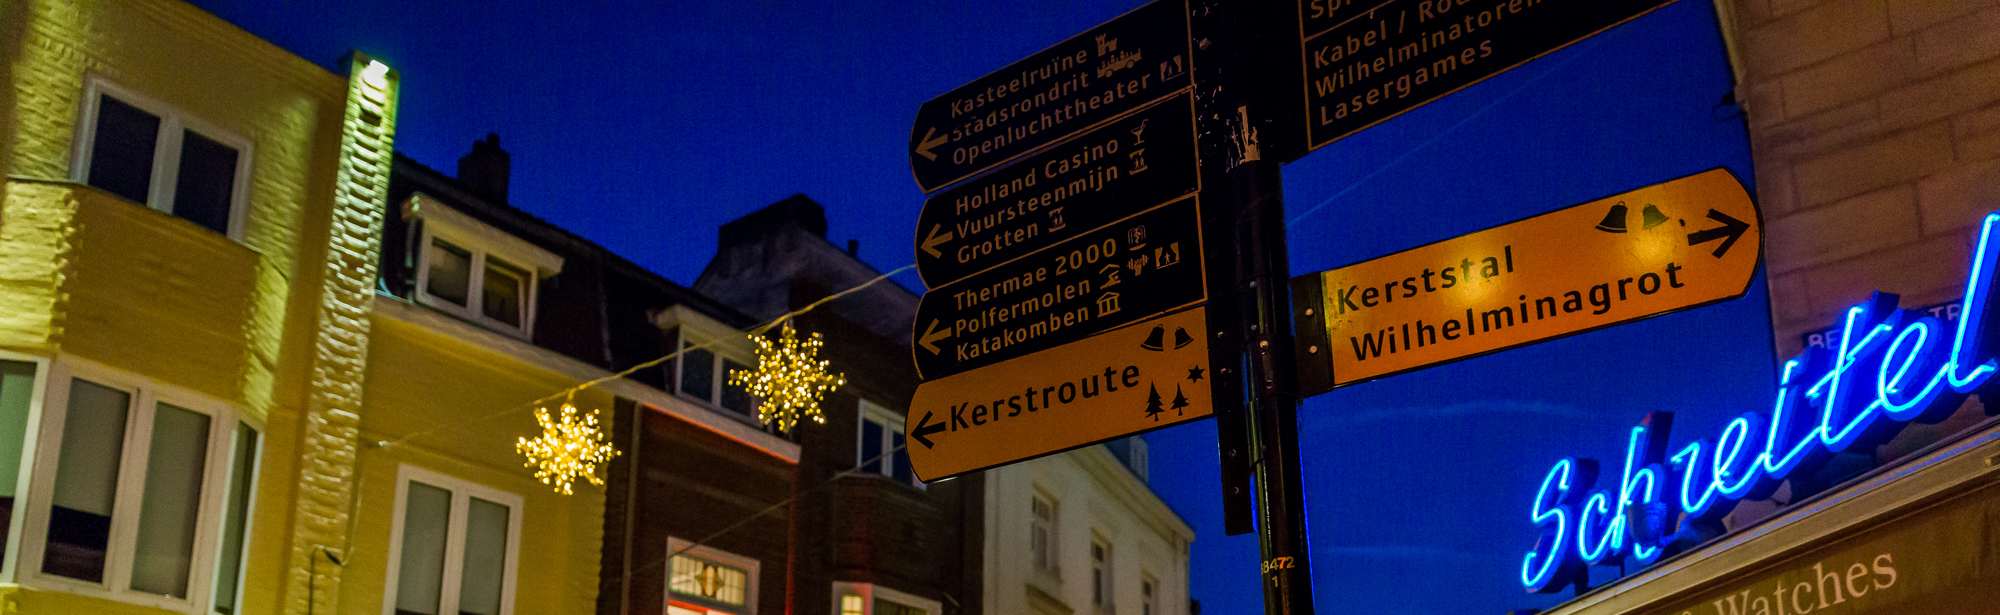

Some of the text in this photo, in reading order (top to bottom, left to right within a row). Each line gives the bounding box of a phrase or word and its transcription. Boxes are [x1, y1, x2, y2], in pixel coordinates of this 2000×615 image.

[1314, 19, 1387, 69] Kabel
[1398, 10, 1406, 34] /
[951, 49, 1087, 118] Kasteelruïne
[952, 71, 1089, 142] Stadsrondrit
[1321, 39, 1493, 126] Lasergames
[953, 73, 1150, 165] Openluchttheater
[956, 138, 1119, 216] Holland Casino
[956, 165, 1118, 239] Vuursteenmijn
[954, 238, 1117, 310] Thermae 2000
[957, 221, 1038, 263] Grotten
[955, 279, 1091, 338] Polfermolen
[1338, 245, 1514, 315] Kerststal
[1350, 261, 1685, 361] Wilhelminagrot
[957, 306, 1089, 362] Katakomben
[951, 364, 1140, 432] Kerstroute
[1521, 212, 2000, 590] Schreitel
